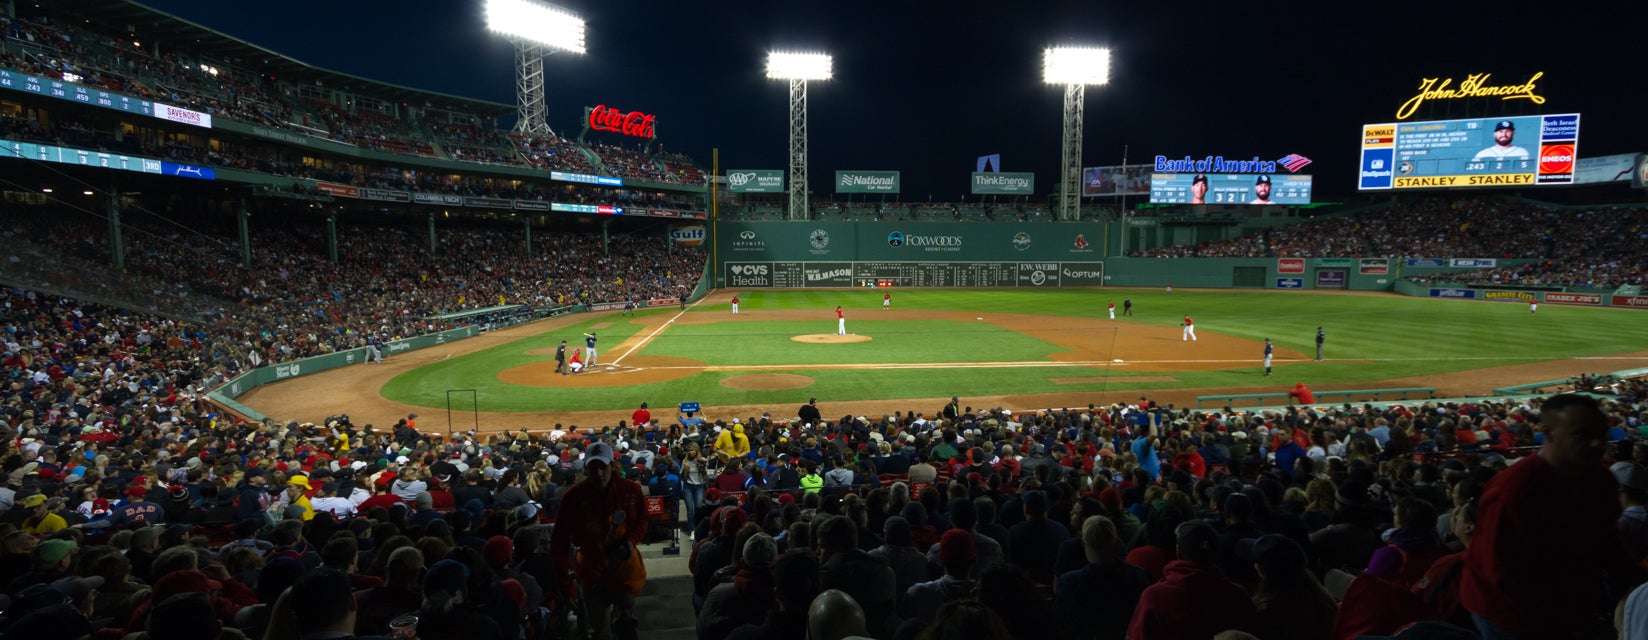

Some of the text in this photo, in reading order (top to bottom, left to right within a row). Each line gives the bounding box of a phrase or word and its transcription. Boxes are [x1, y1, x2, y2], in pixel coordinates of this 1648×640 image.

[1396, 71, 1545, 120] John Hancock
[589, 104, 656, 139] Coca-Cola
[81, 156, 87, 164] 3
[101, 158, 108, 167] 2
[145, 162, 160, 171] 3RD
[1154, 155, 1276, 173] Bank of America
[853, 175, 894, 185] National
[1396, 174, 1532, 187] STANLEY STANLEY
[1216, 193, 1245, 202] 3 2 1
[670, 229, 704, 239] Gulf
[906, 234, 962, 246] FOXWOODS
[743, 265, 768, 275] CVS
[732, 276, 768, 286] Health
[1546, 294, 1575, 302] TRADER
[125, 505, 156, 516] DAD
